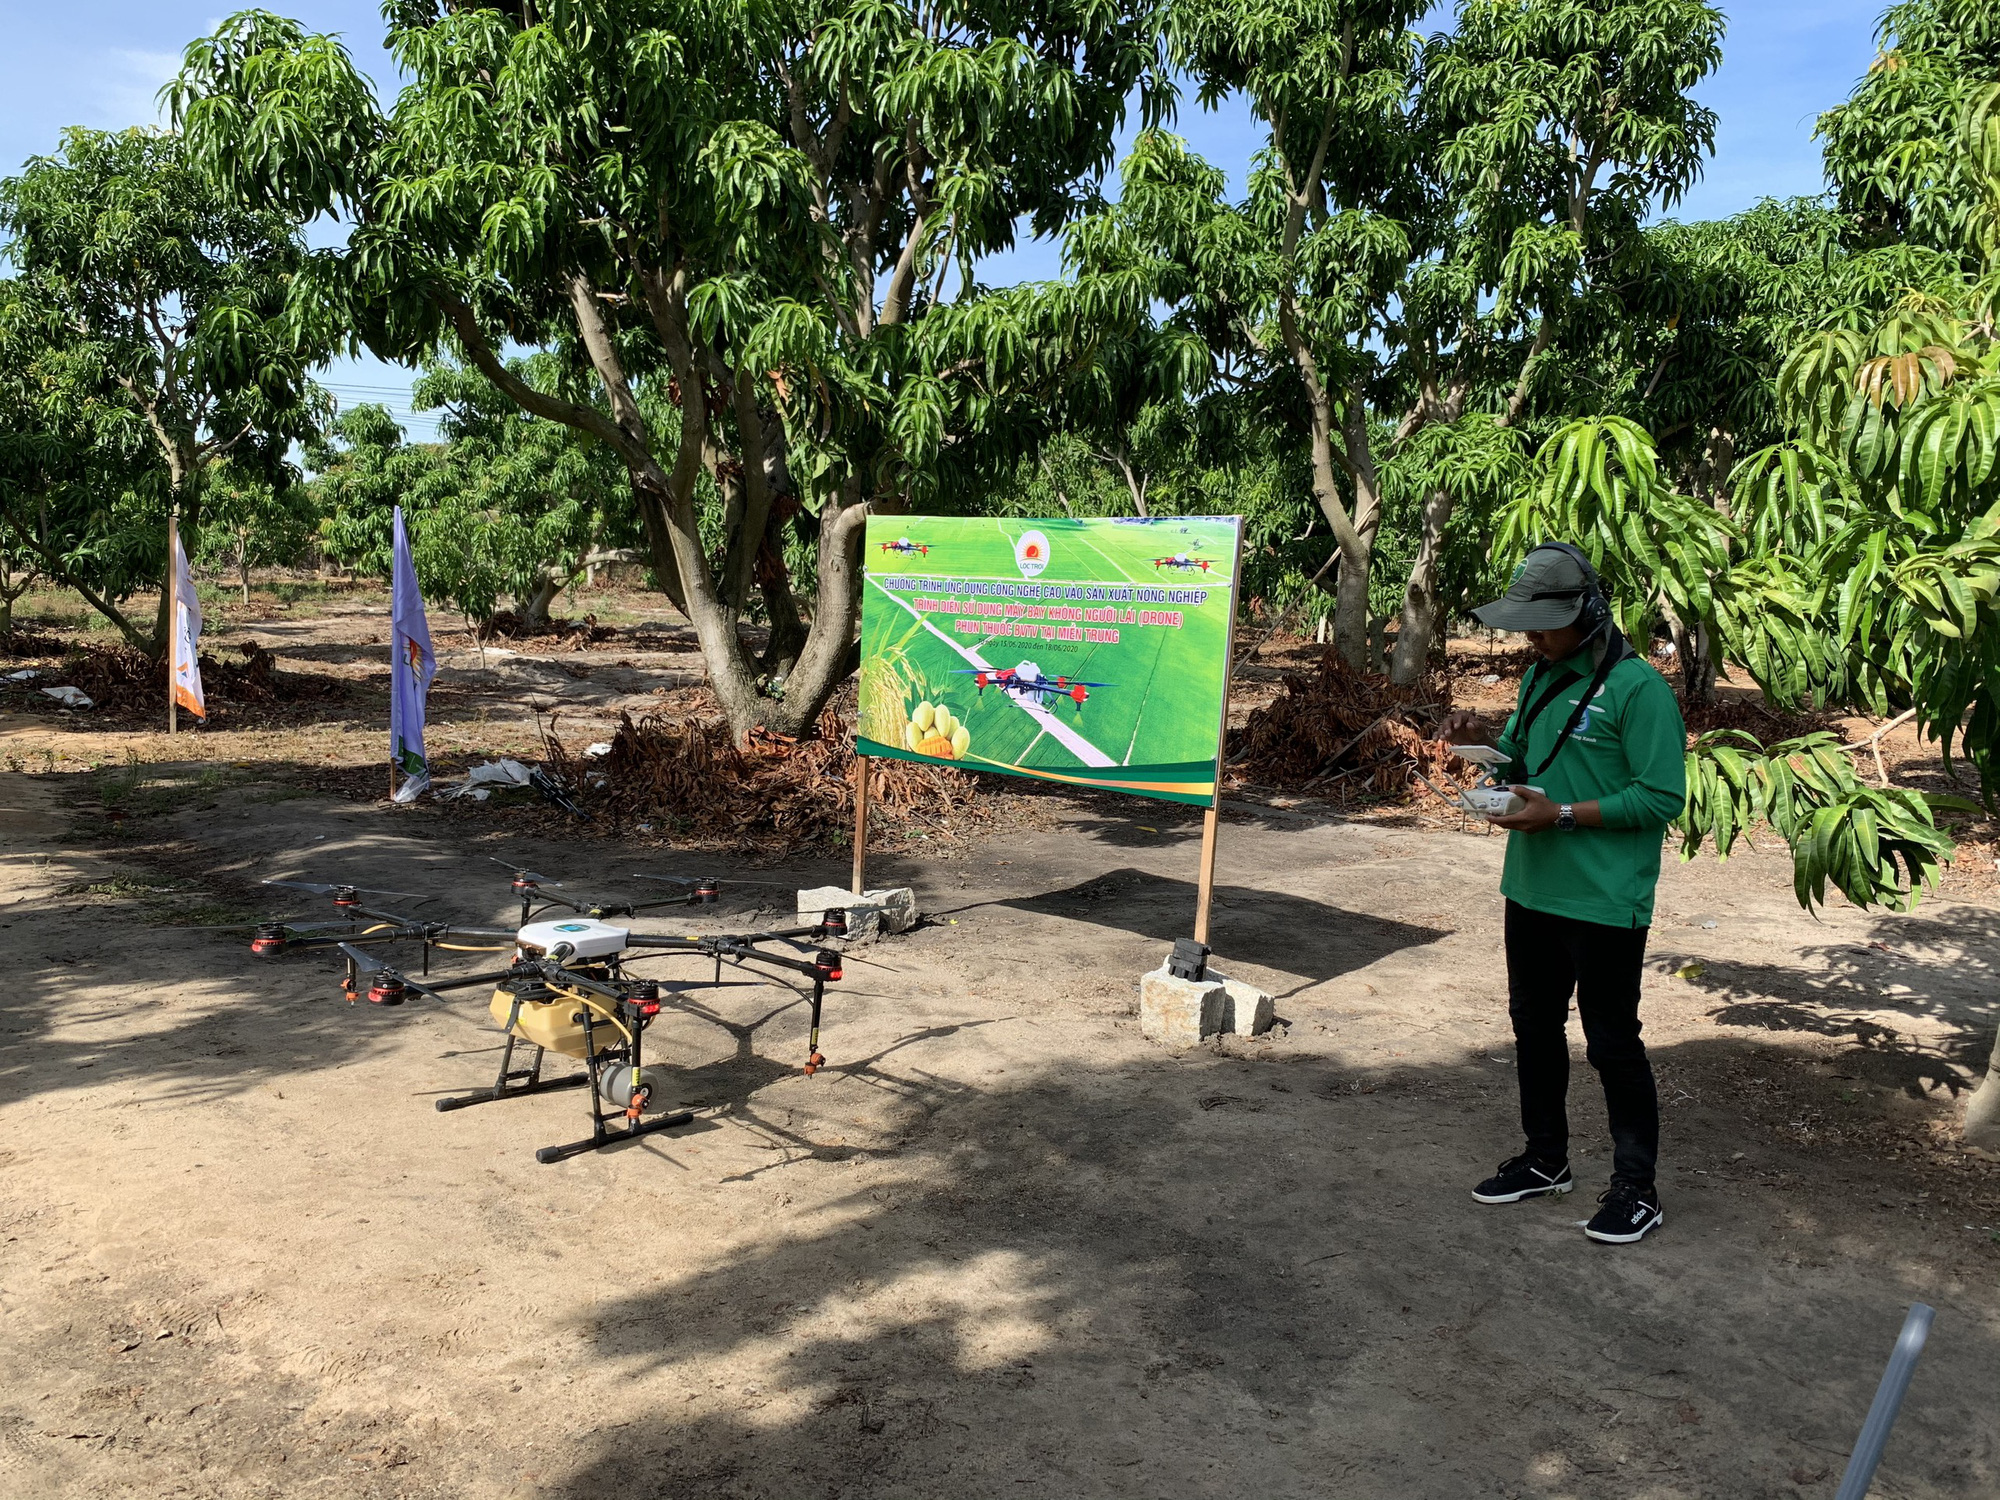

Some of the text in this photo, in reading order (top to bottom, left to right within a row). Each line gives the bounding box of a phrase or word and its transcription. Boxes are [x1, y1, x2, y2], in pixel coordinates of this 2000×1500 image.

[919, 577, 942, 591] TRÌNH
[964, 582, 988, 597] DỤNG
[991, 580, 1014, 596] CÔNG
[1017, 582, 1041, 600] NGHỆ
[1044, 586, 1062, 599] CAO
[1064, 583, 1083, 600] VÀO
[1086, 584, 1105, 600] SẢN
[1108, 583, 1133, 601] XUẤT
[1137, 586, 1164, 602] NÔNG
[1169, 587, 1208, 606] NGHIỆP
[913, 595, 938, 611] TRÌNH
[977, 602, 1002, 618] DỤNG
[1005, 601, 1025, 617] MÁY
[1027, 606, 1046, 618] BAY
[1048, 604, 1082, 620] KHÔNG
[1085, 605, 1116, 622] NGƯỜI
[1119, 606, 1136, 623] LÁI
[1139, 610, 1183, 629] (DRONE)
[955, 617, 1119, 643] PHUN THUỐC BVTV TẠI MIỀN TRUNG
[1631, 1208, 1647, 1224] adidas
